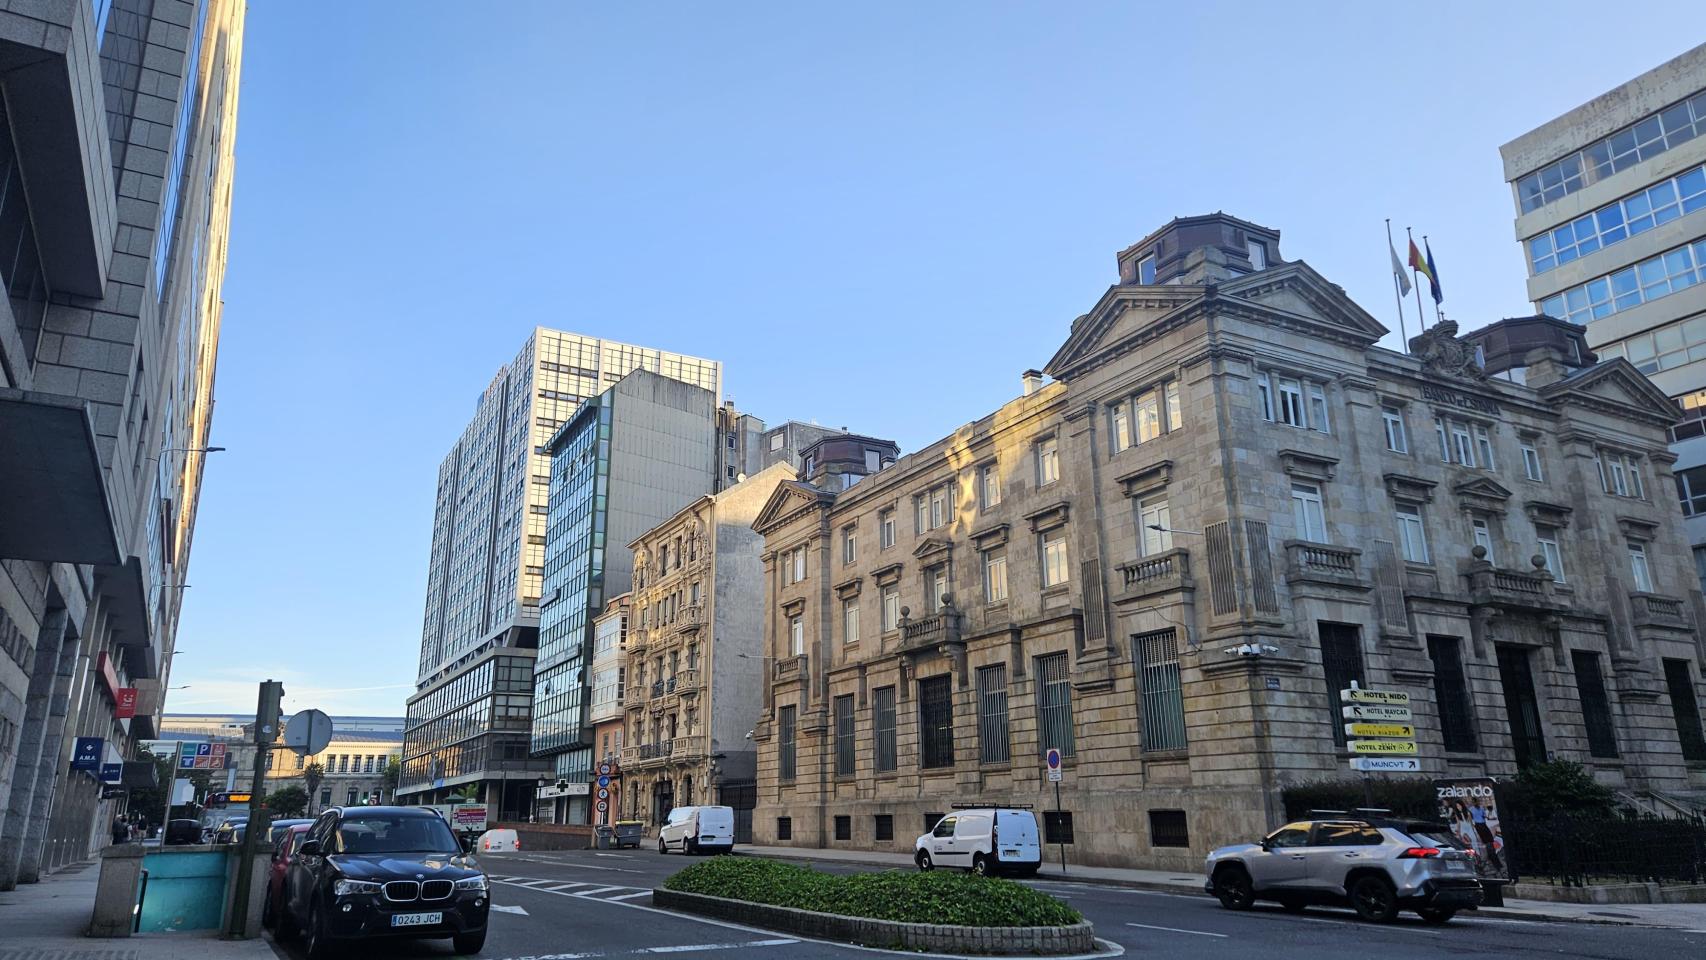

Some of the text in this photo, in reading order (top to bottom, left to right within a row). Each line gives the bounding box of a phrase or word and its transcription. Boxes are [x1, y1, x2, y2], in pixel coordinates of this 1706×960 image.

[1364, 691, 1387, 699] HOTEL
[199, 744, 208, 754] P
[1436, 784, 1493, 798] zalando
[397, 914, 441, 925] 0243 JCH
